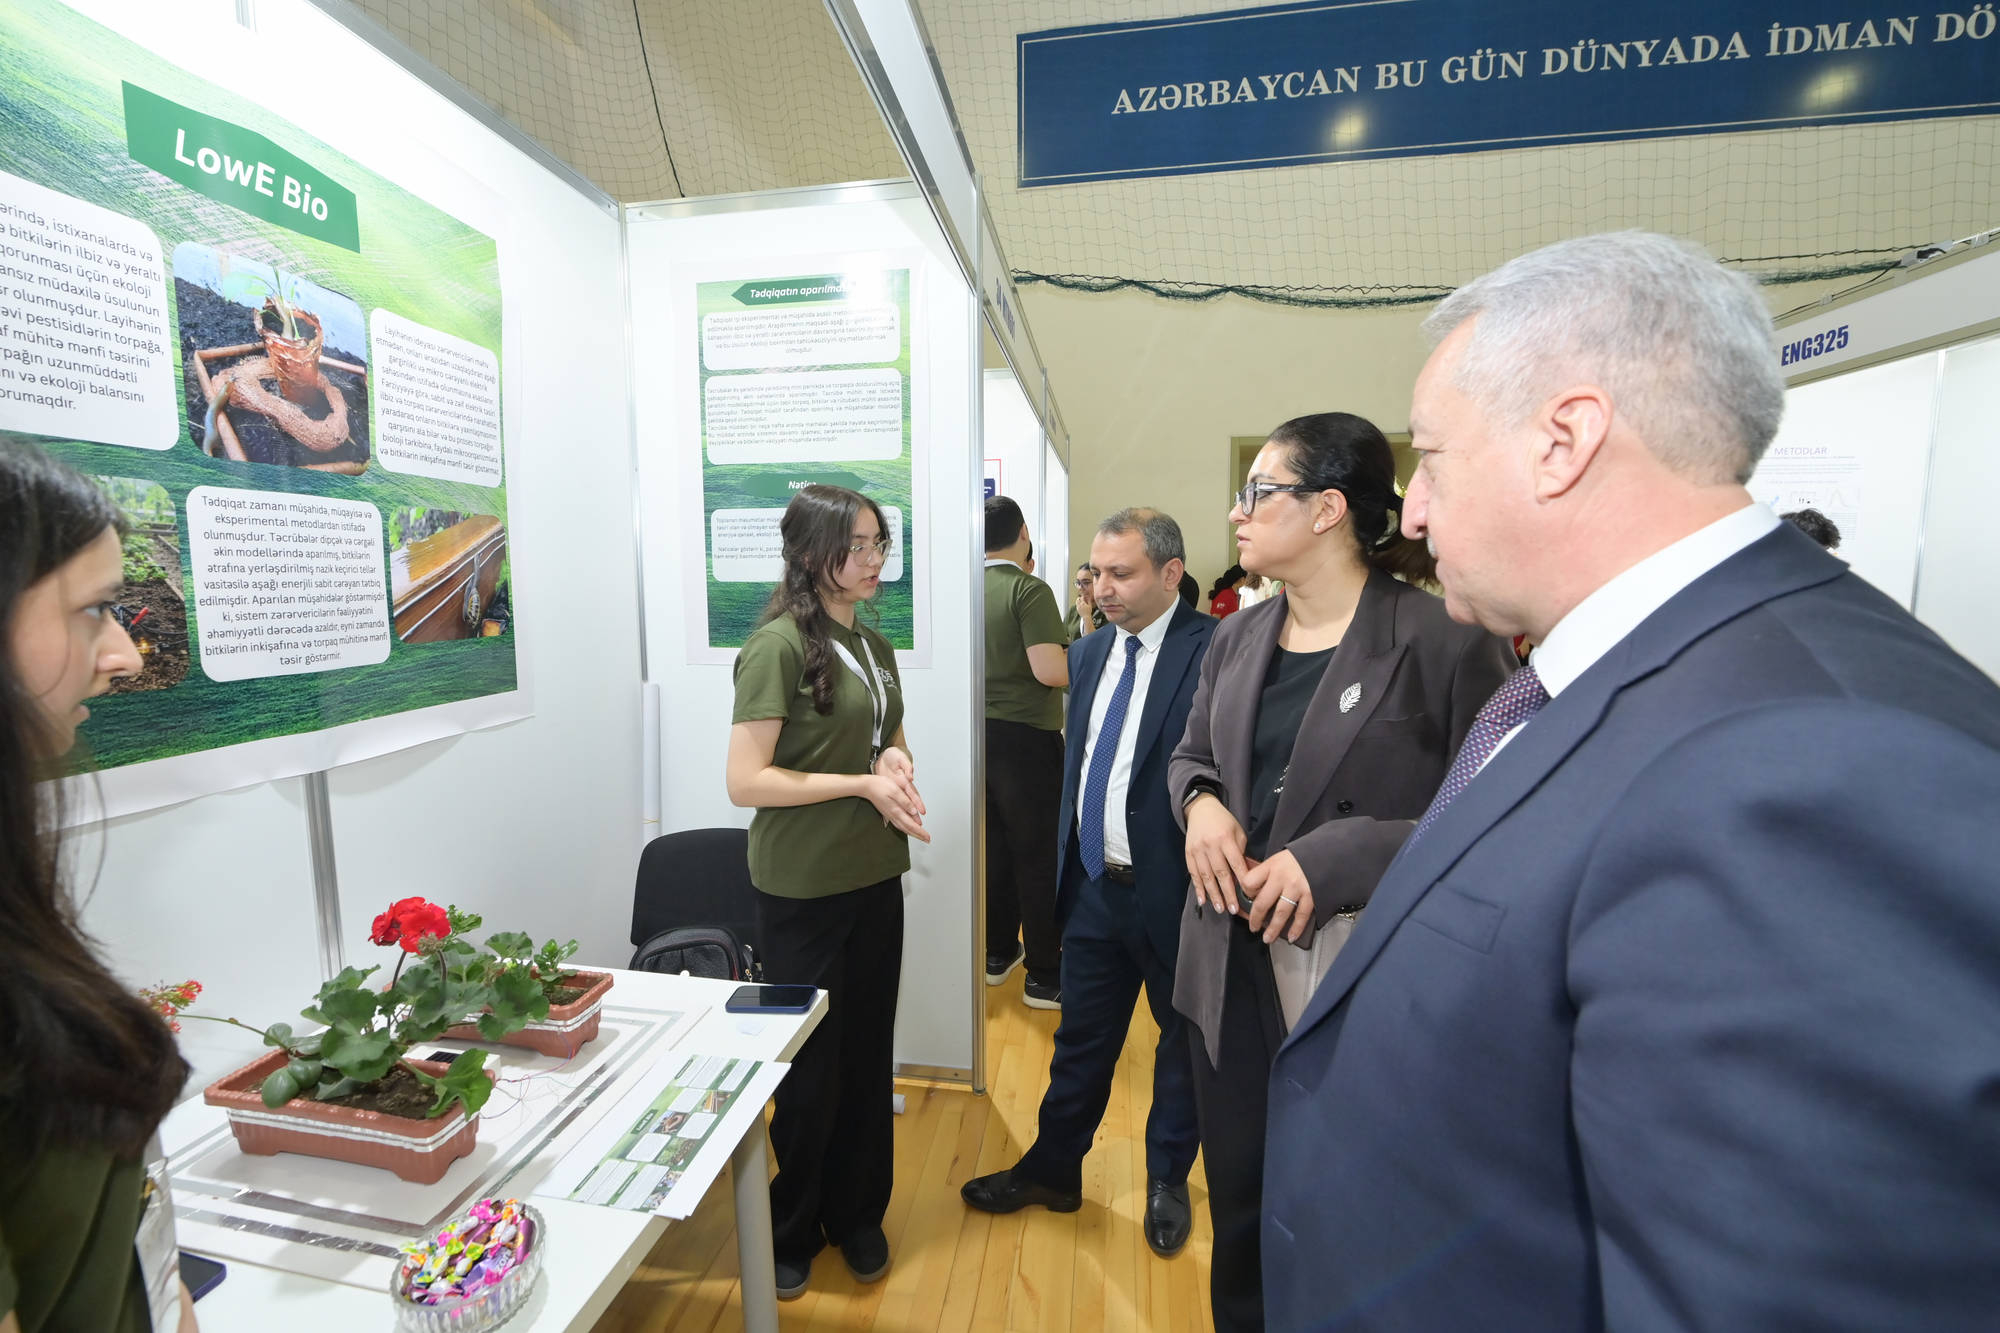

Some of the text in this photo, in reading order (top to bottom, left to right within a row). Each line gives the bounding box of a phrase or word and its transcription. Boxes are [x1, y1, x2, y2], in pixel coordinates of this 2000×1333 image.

[1111, 4, 2000, 114] AZƏRBAYCAN BU GÜN DÜNYADA İDMAN DÖ
[283, 175, 328, 221] Bio
[53, 218, 136, 256] istixanalarda
[139, 250, 153, 262] və
[9, 224, 72, 254] bitkilərin
[76, 245, 102, 264] ilbiz
[106, 258, 121, 270] və
[124, 264, 160, 282] yeraltı
[76, 265, 109, 284] üçün
[112, 278, 151, 299] ekoloji
[750, 287, 799, 299] Tədqiqatın
[38, 276, 101, 301] müdaxilə
[104, 292, 160, 317] üsulunun
[13, 289, 100, 319] olunmuşdur.
[104, 311, 161, 335] Layihənin
[26, 313, 111, 341] pestisidlərin
[114, 333, 164, 355] torpağa,
[1780, 325, 1849, 366] ENG325
[13, 330, 64, 349] mühitə
[68, 342, 106, 358] mənfi
[109, 350, 150, 368] təsirini
[47, 357, 137, 383] uzunmüddətli
[19, 372, 36, 383] və
[40, 374, 86, 394] ekoloji
[89, 382, 144, 402] balansını
[202, 496, 247, 510] Tədqiqat
[250, 502, 287, 511] zamanı
[289, 503, 330, 516] müşahidə,
[215, 514, 289, 527] eksperimental
[291, 520, 340, 530] metodlardan
[203, 530, 267, 543] olunmuşdur.
[269, 532, 318, 543] Təcrübələr
[214, 546, 234, 556] əkin
[236, 548, 304, 558] modellərində
[208, 562, 246, 573] ətrafına
[248, 564, 314, 576] yerləşdirilmiş
[204, 579, 249, 589] vasitəsilə
[252, 579, 278, 591] aşağı
[314, 579, 332, 588] sabit
[199, 595, 250, 608] edilmişdir.
[252, 594, 296, 606] Aparılan
[298, 593, 344, 605] müşahidələr
[222, 612, 233, 623] ki,
[235, 611, 268, 621] sistem
[207, 626, 264, 640] əhəmiyyətli
[267, 624, 313, 635] dərəcədə
[356, 620, 385, 630] zamanda
[205, 644, 248, 656] bitkilərin
[250, 640, 299, 653] inkişafına
[314, 638, 338, 648] torpaq
[280, 655, 302, 665] təsir
